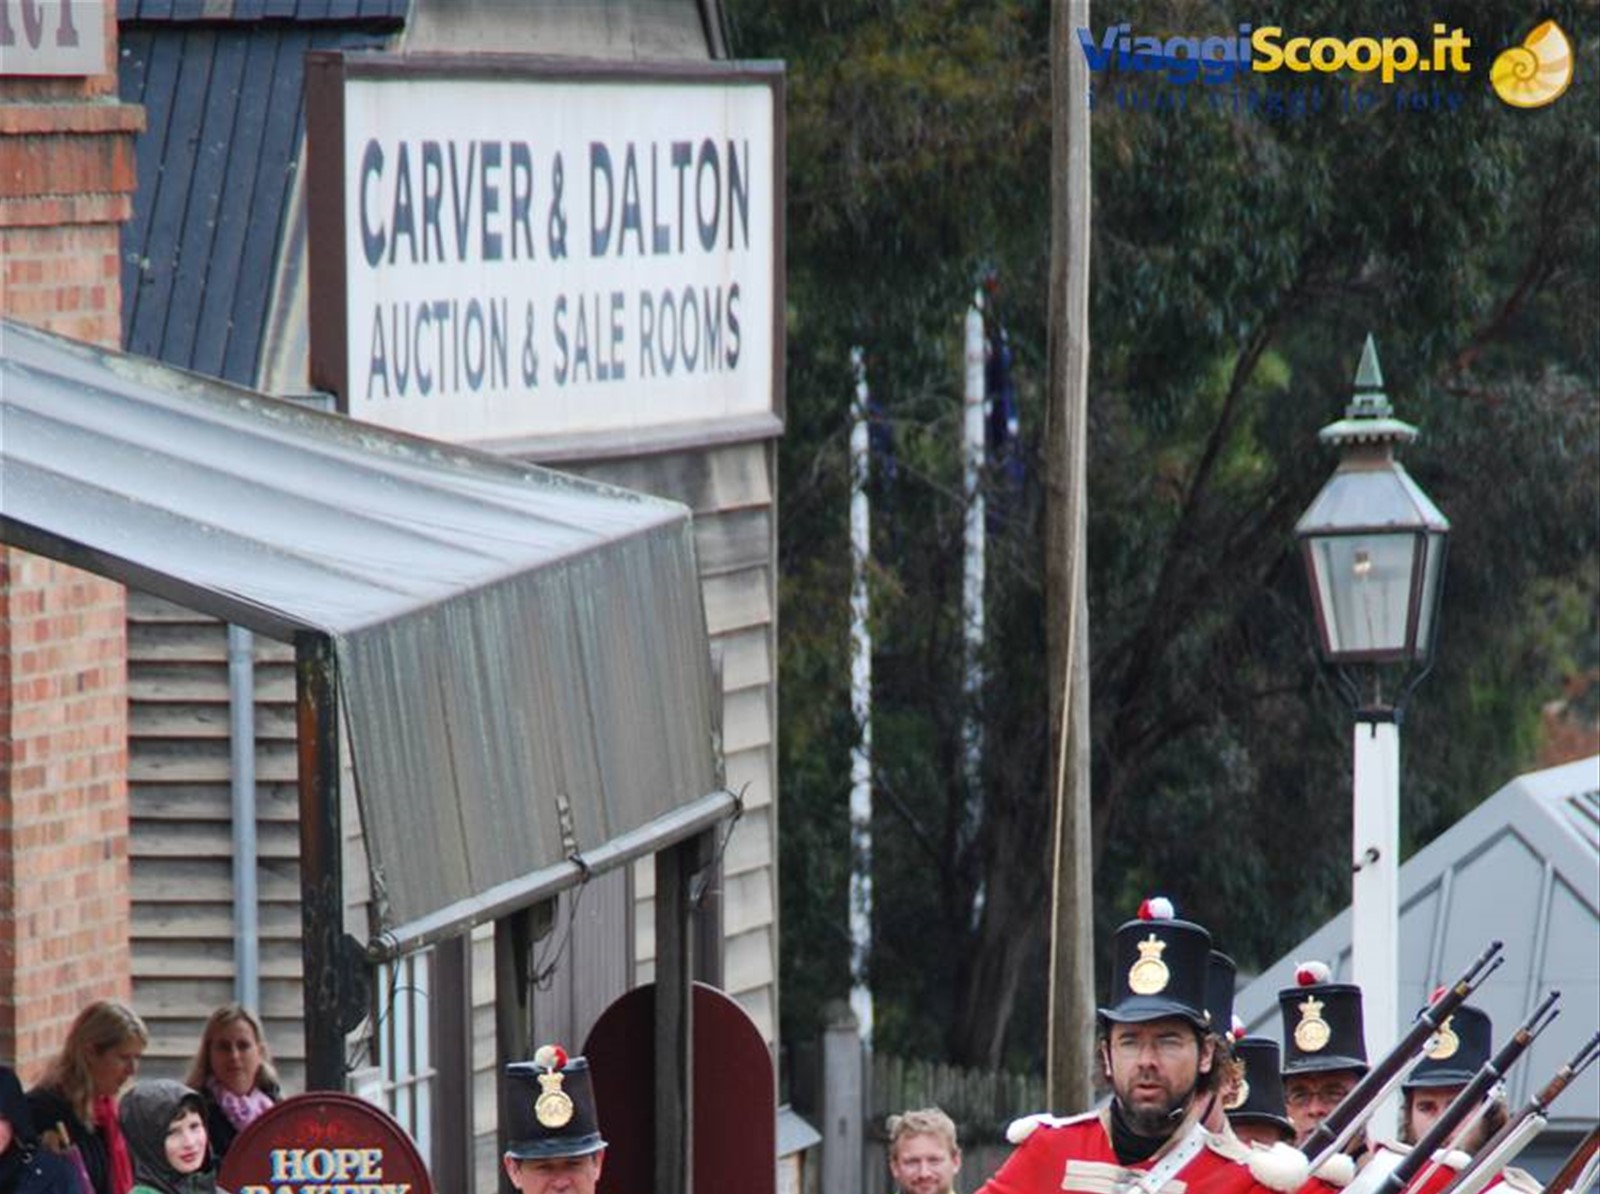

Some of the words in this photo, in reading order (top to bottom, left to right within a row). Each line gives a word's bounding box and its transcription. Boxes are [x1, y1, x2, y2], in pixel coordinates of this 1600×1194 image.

[360, 137, 535, 268] CARVER
[548, 151, 568, 260] &
[590, 138, 750, 258] DALTON
[366, 297, 508, 400] AUCTION
[520, 293, 538, 388] &
[553, 290, 625, 385] SALE
[640, 283, 741, 378] ROOMS
[270, 1148, 383, 1183] HOPE
